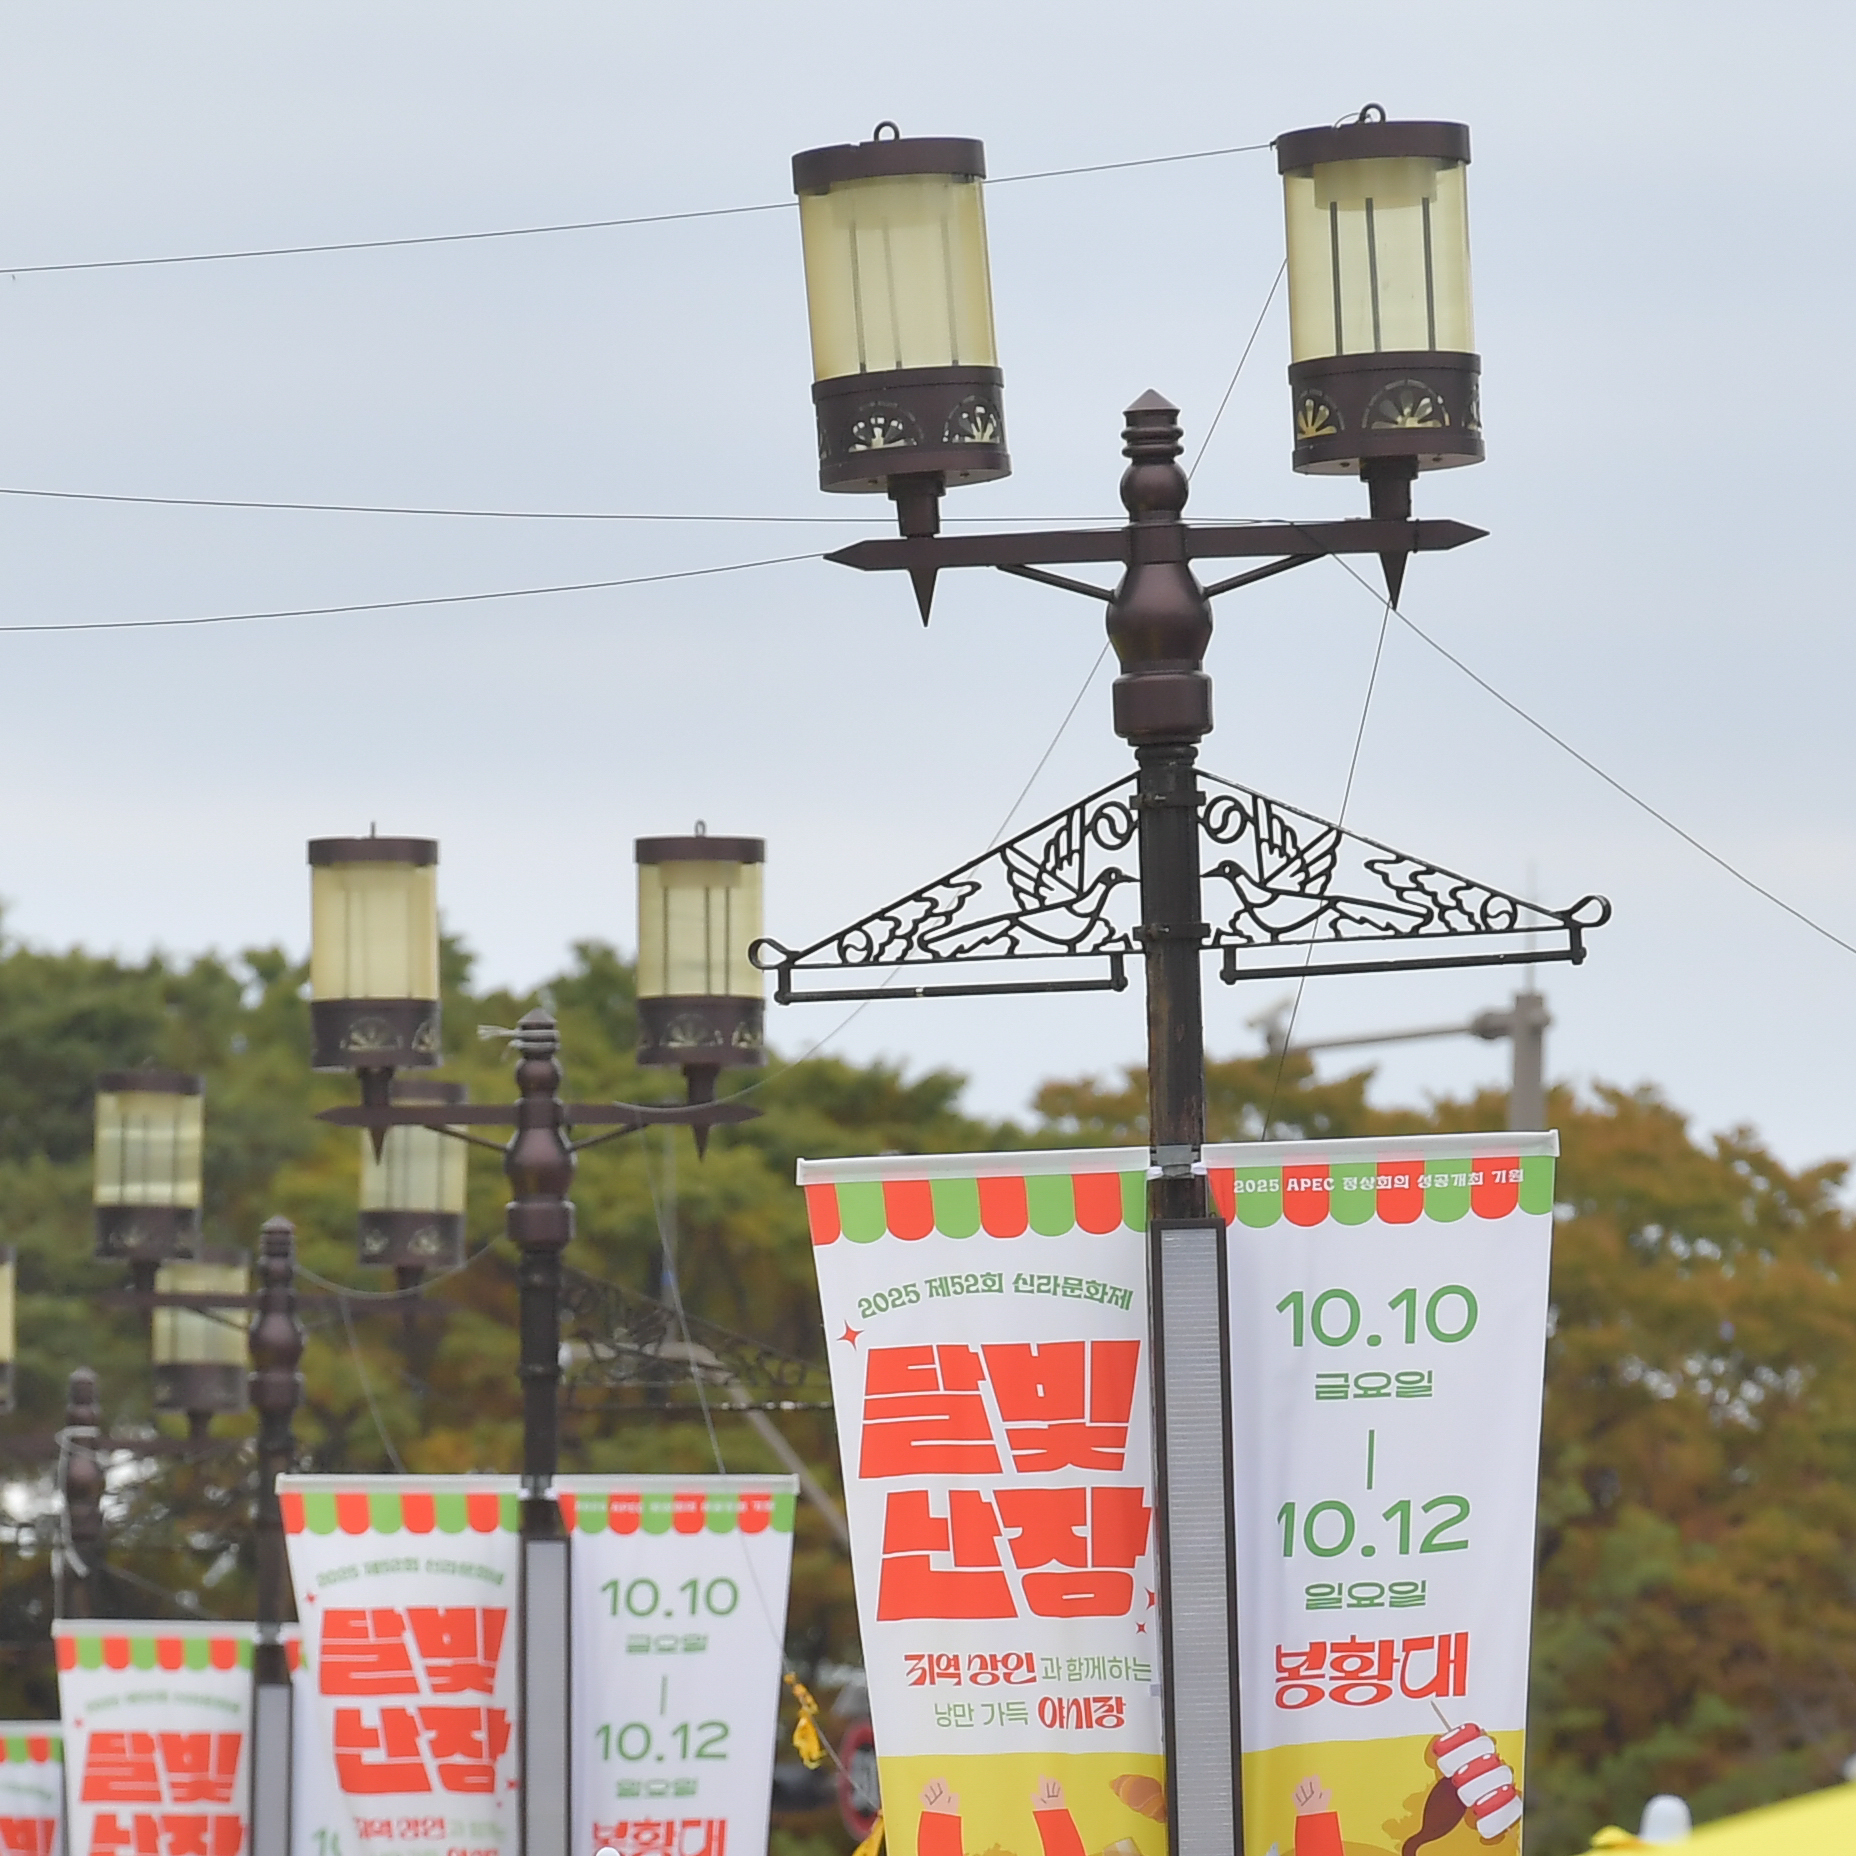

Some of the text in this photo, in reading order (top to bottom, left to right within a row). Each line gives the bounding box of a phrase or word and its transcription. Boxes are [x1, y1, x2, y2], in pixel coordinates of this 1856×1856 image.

[1233, 1168, 1525, 1195] 2025 APEC 정상회의 성공개최 기원
[857, 1271, 1135, 1320] 2025 제52회 신라문화제
[1274, 1283, 1480, 1349] 10.10
[857, 1339, 1142, 1480] 달빛
[1313, 1368, 1436, 1402] 금요일
[875, 1485, 1152, 1623] 난장
[1276, 1493, 1472, 1560] 10.12
[600, 1575, 740, 1619] 10.10
[1303, 1578, 1430, 1612] 일요일
[318, 1605, 509, 1697] 달빛
[904, 1652, 962, 1687] 지역
[1273, 1629, 1471, 1712] 봉황대
[934, 1696, 1127, 1730] 낭만 가득 야시장
[80, 1730, 243, 1804] 달빛
[333, 1706, 512, 1795] 난장
[595, 1720, 730, 1764] 10.12
